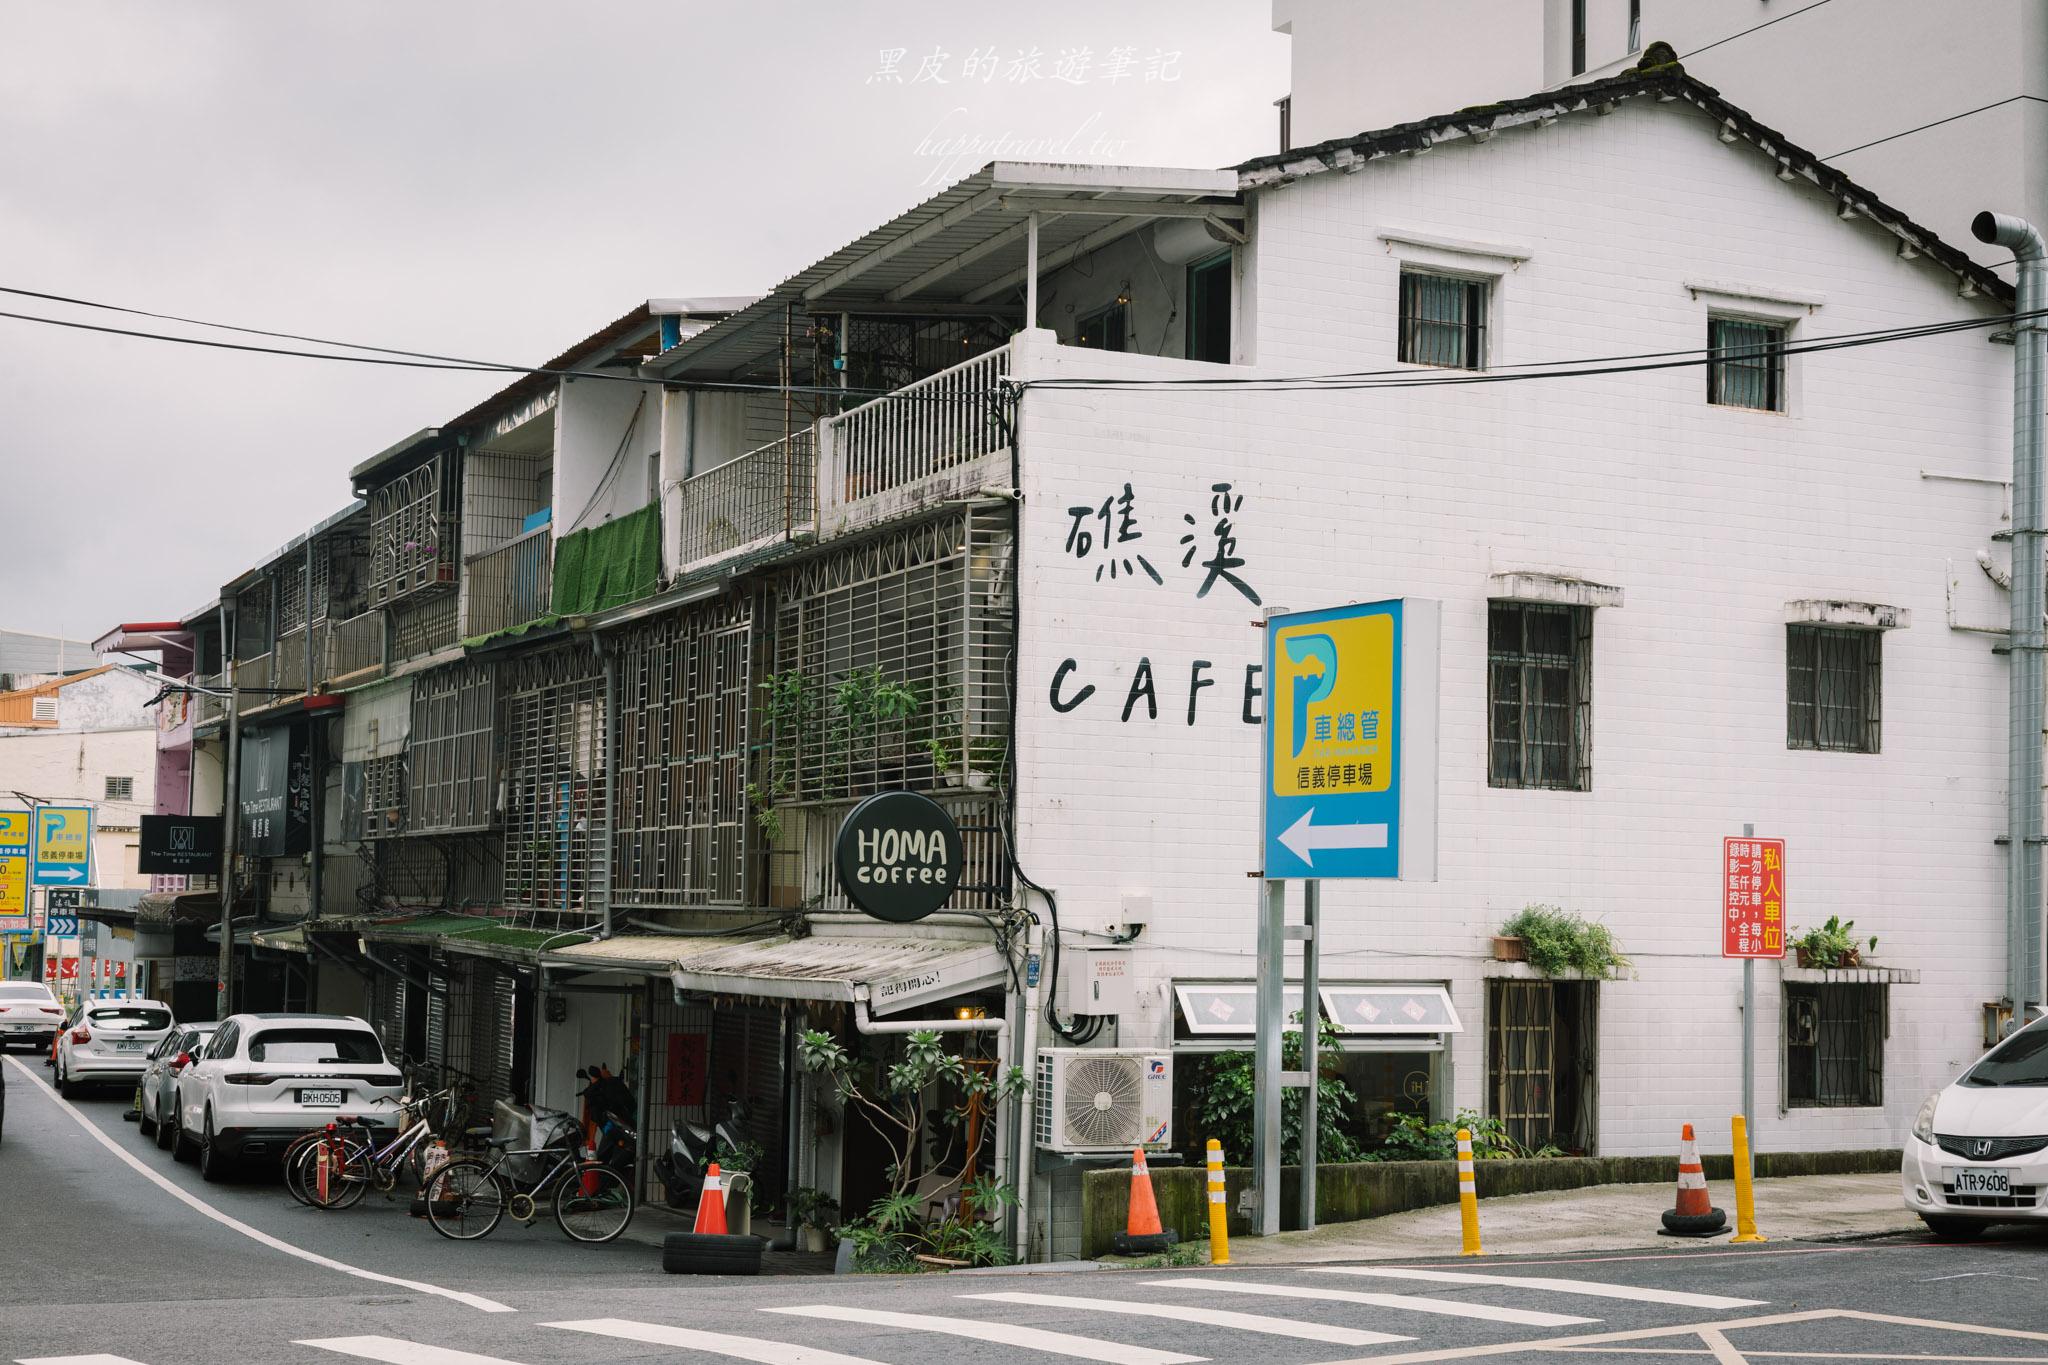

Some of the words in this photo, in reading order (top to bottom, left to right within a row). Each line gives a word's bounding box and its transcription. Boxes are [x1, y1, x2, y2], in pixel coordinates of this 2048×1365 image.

[1066, 482, 1262, 606] 礁溪
[1050, 657, 1262, 726] CAFE
[1313, 710, 1380, 743] 車總管
[1296, 763, 1373, 790] 信義停車場
[858, 828, 947, 865] HOMA
[1764, 848, 1780, 949] 私人車位
